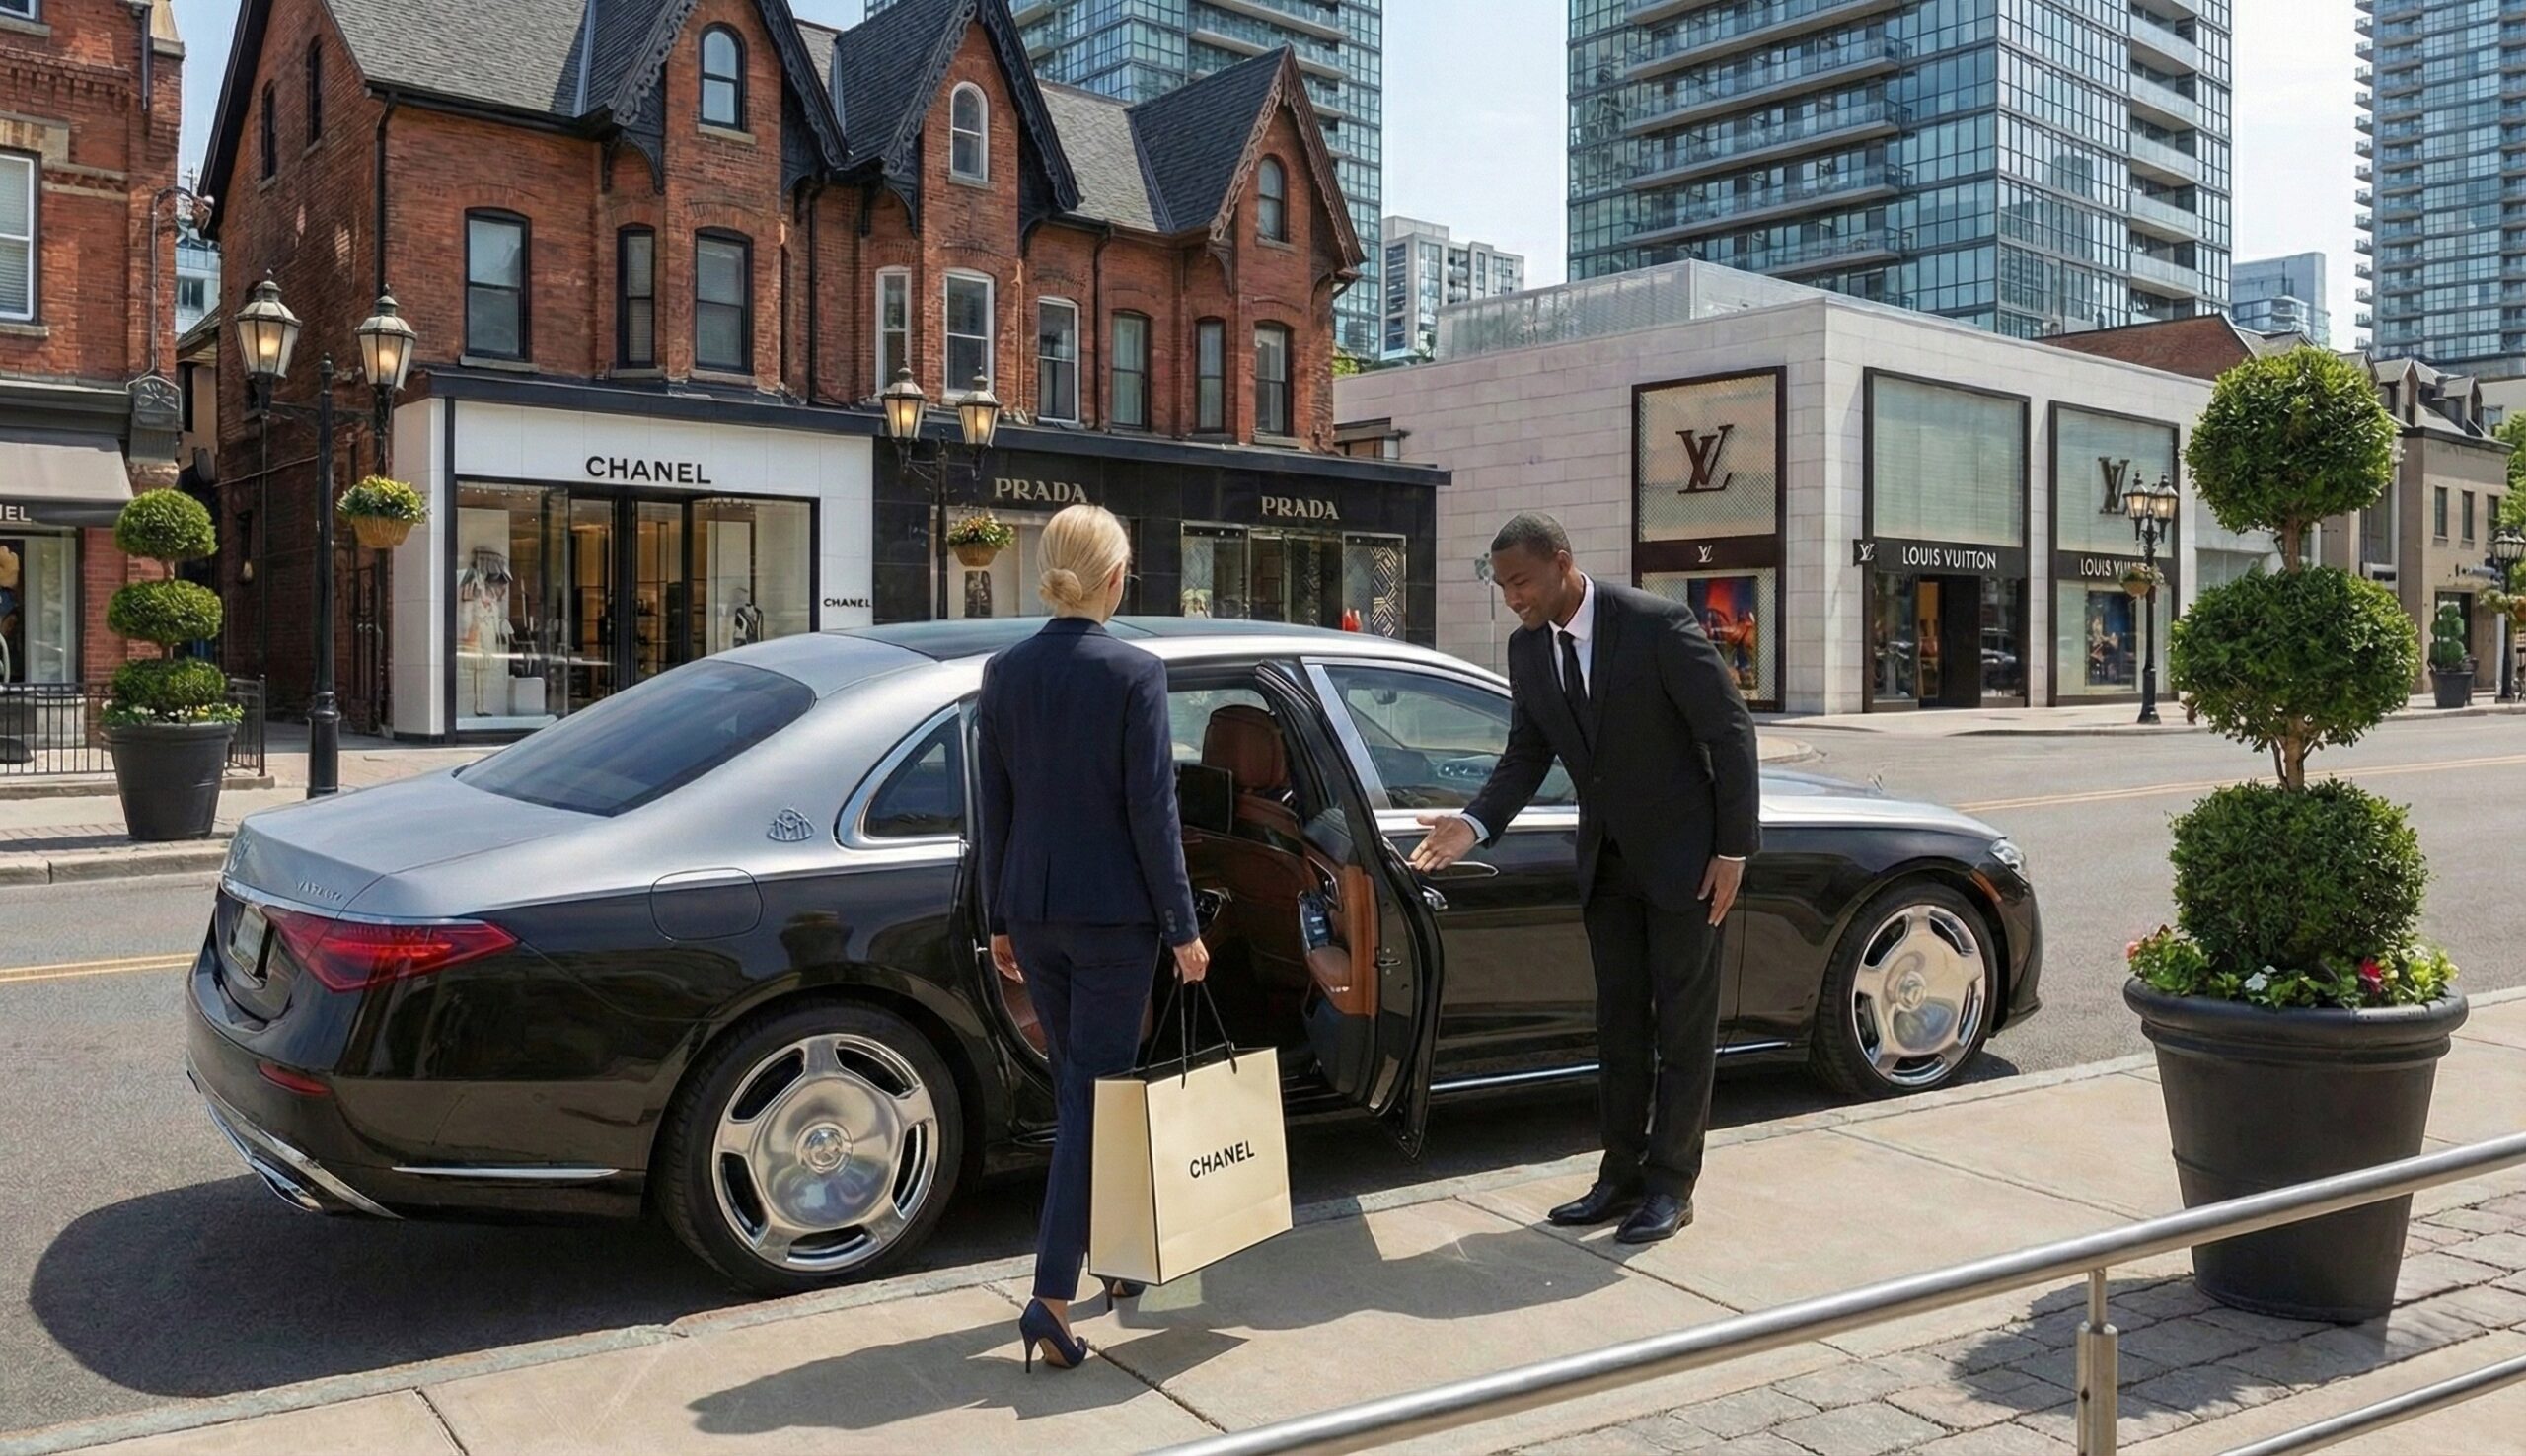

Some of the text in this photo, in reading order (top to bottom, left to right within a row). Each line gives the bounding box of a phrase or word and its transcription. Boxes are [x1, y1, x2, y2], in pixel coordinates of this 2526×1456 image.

[585, 455, 711, 484] CHANEL
[994, 477, 1088, 503] PRADA
[0, 504, 33, 522] EL
[1261, 495, 1340, 520] PRADA
[1902, 546, 1997, 570] LOUIS VUITTON
[2080, 557, 2112, 577] LOUIS
[823, 597, 871, 608] CHANEL
[1189, 1139, 1255, 1179] CHANEL
